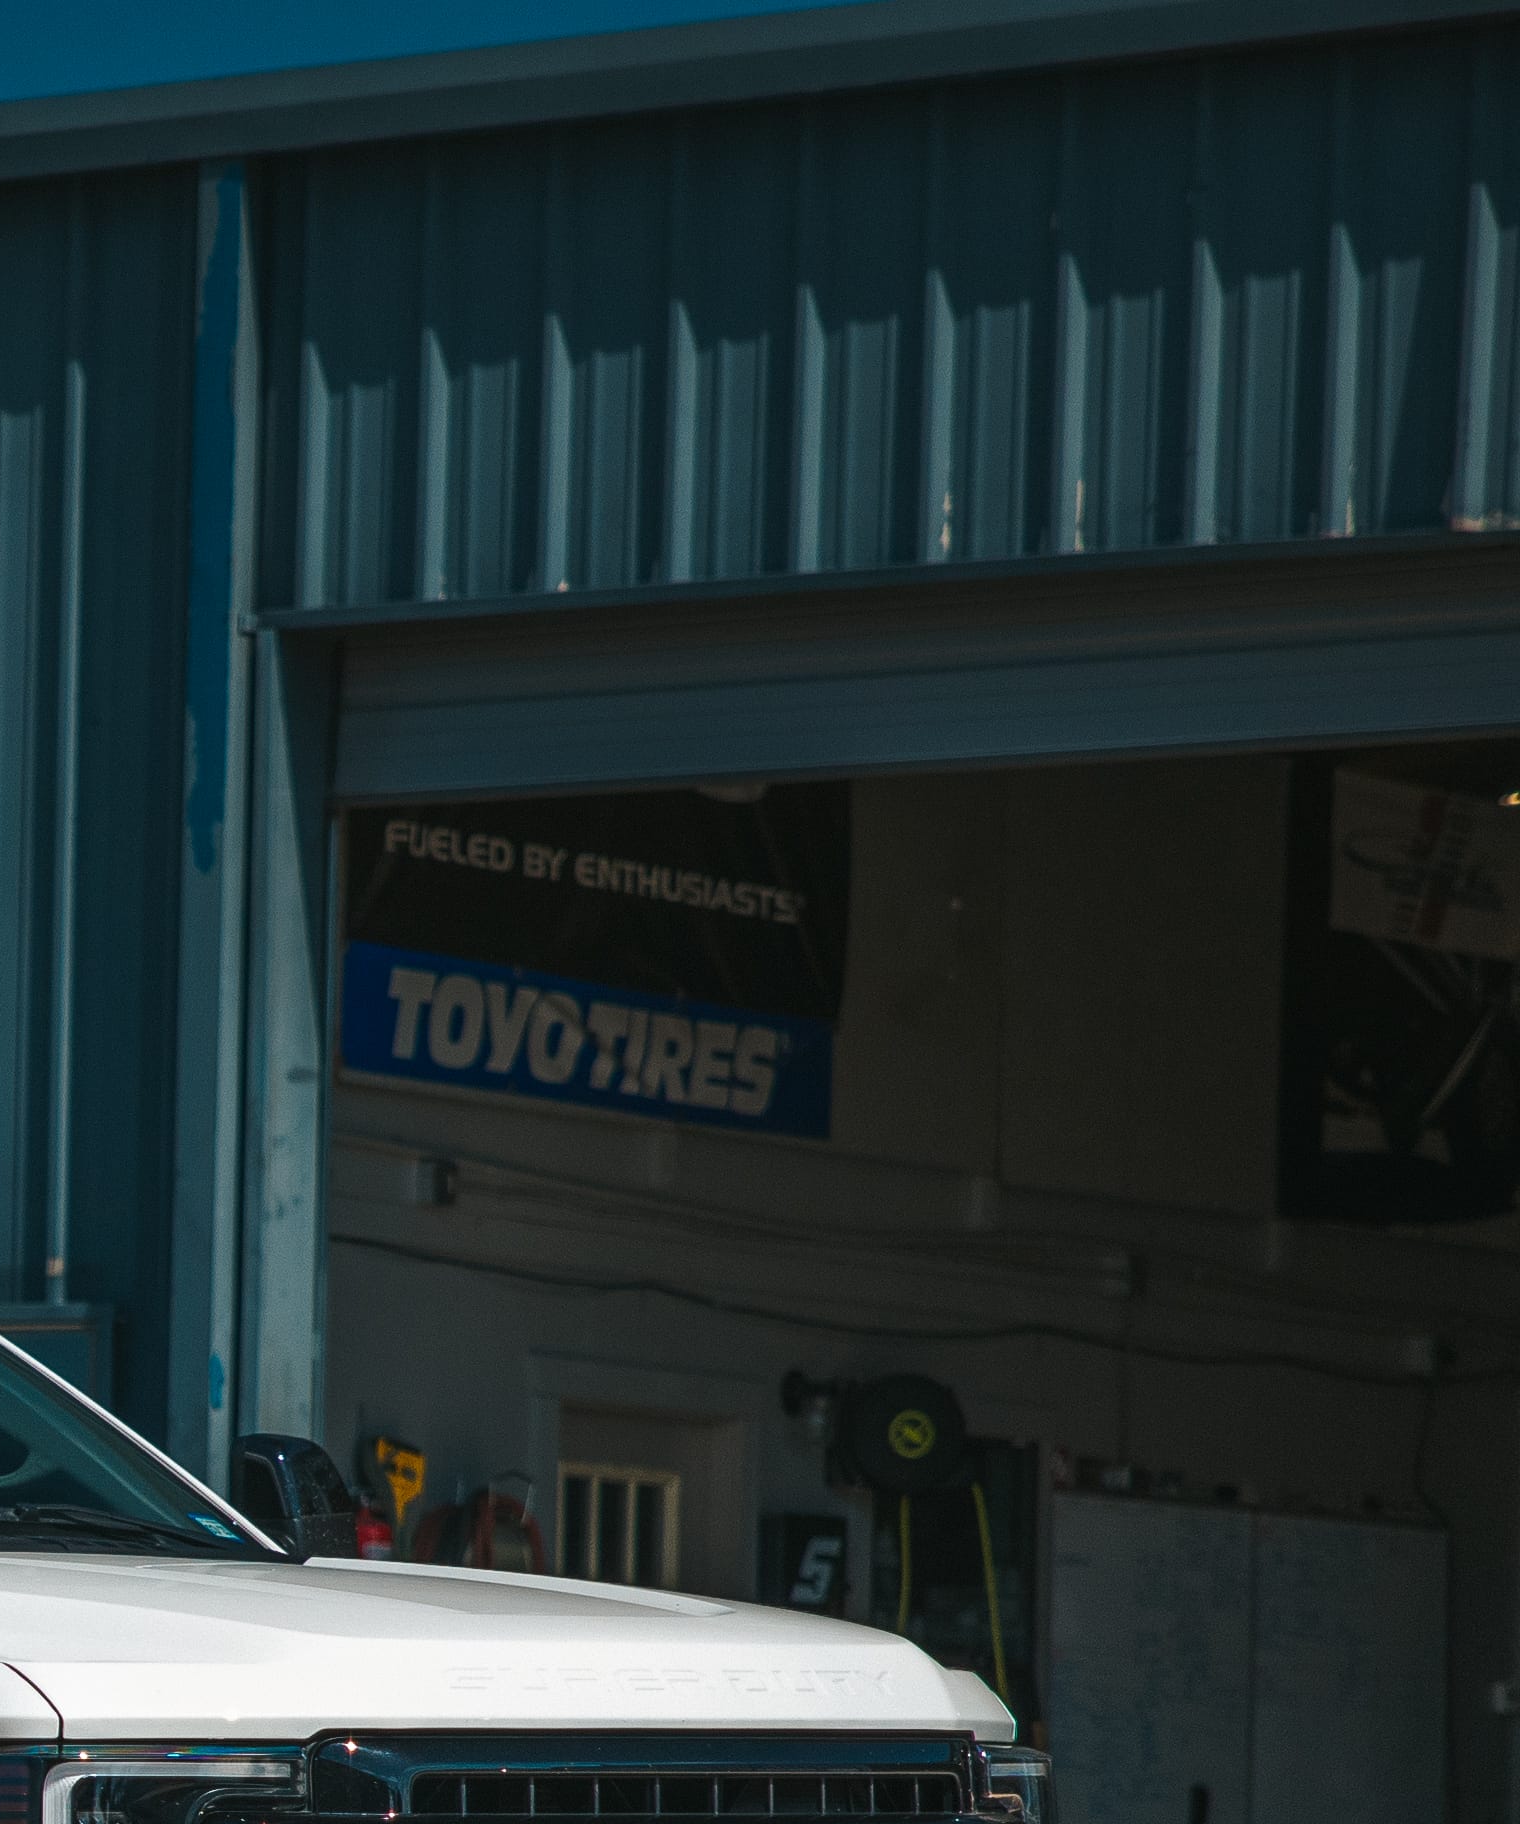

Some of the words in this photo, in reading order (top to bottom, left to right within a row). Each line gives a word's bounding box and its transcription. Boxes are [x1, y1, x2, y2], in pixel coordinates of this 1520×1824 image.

[383, 819, 514, 873] FUELED
[521, 842, 568, 882] BY
[573, 852, 800, 926] ENTHUSIASTS
[387, 965, 585, 1086] TOYO
[585, 1002, 779, 1118] TIRES
